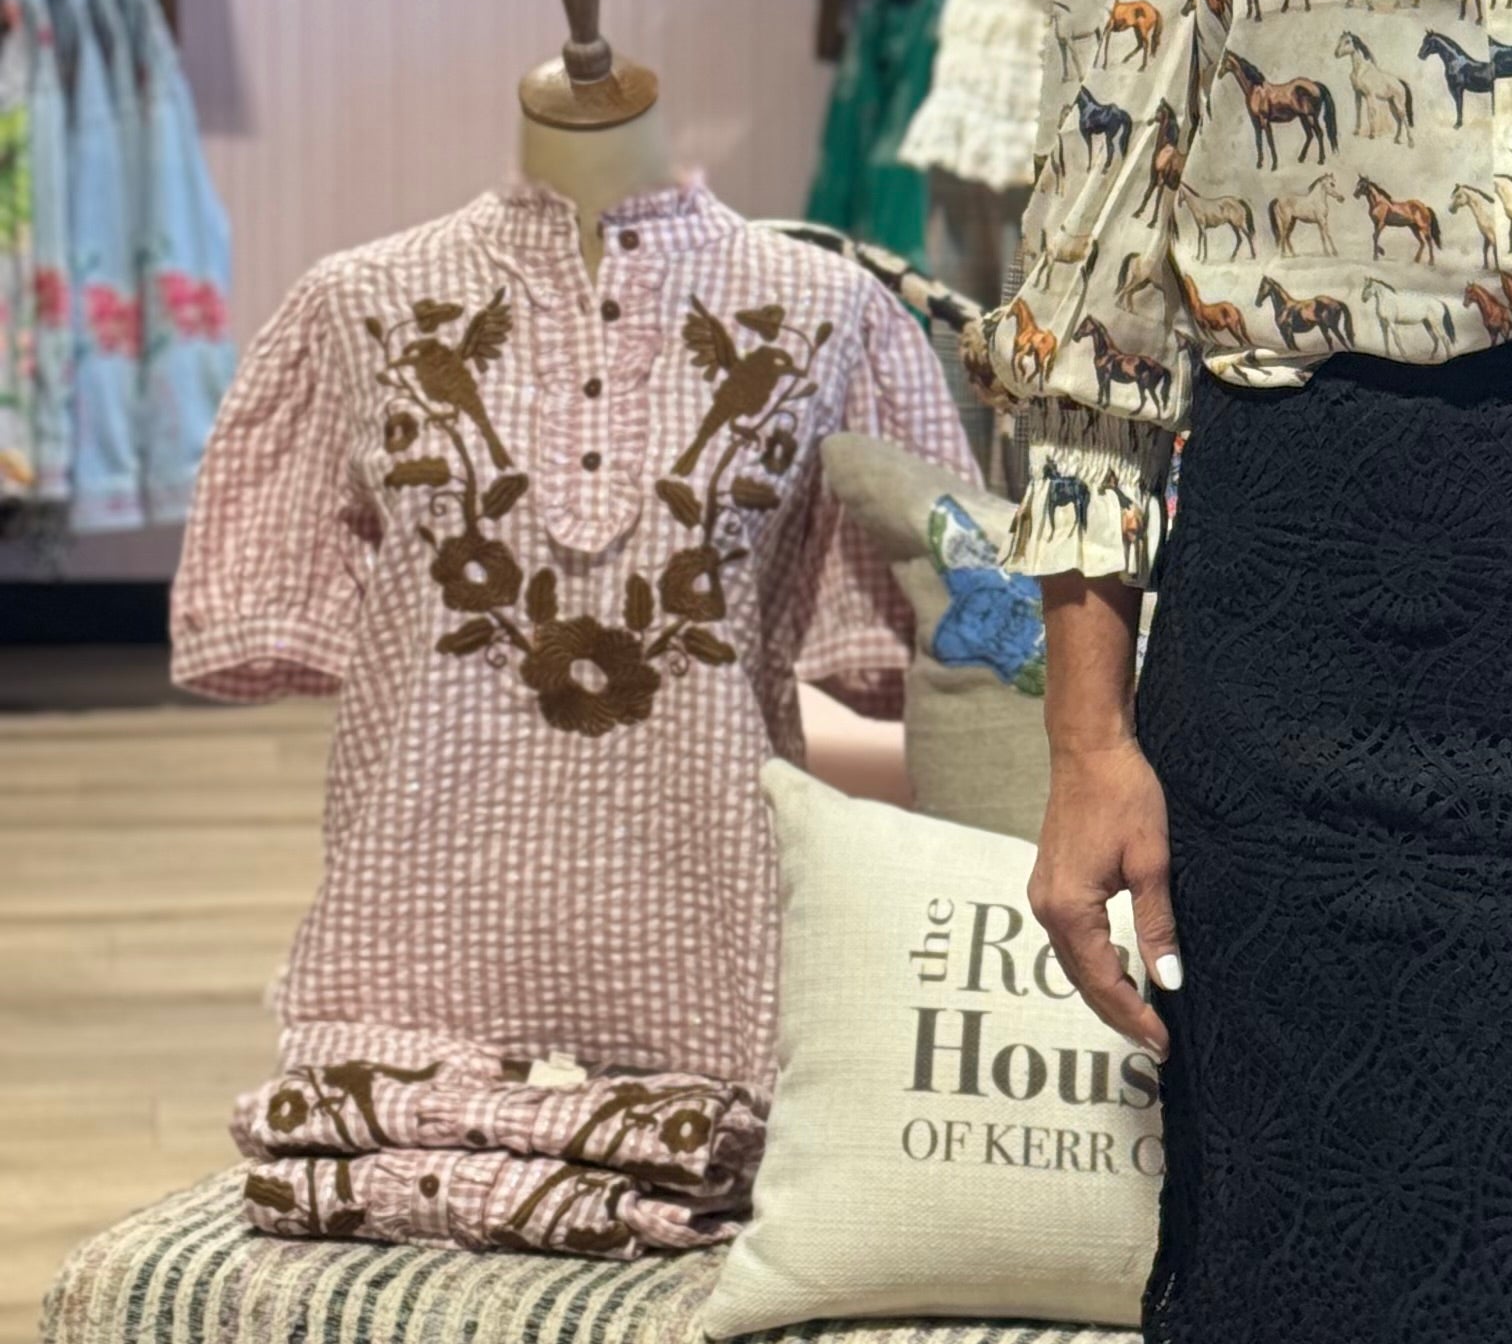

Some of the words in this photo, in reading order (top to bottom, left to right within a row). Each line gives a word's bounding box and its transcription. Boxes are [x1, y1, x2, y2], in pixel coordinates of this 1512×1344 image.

[909, 898, 954, 985] the
[902, 1118, 972, 1162] OF
[981, 1123, 1119, 1174] KERR
